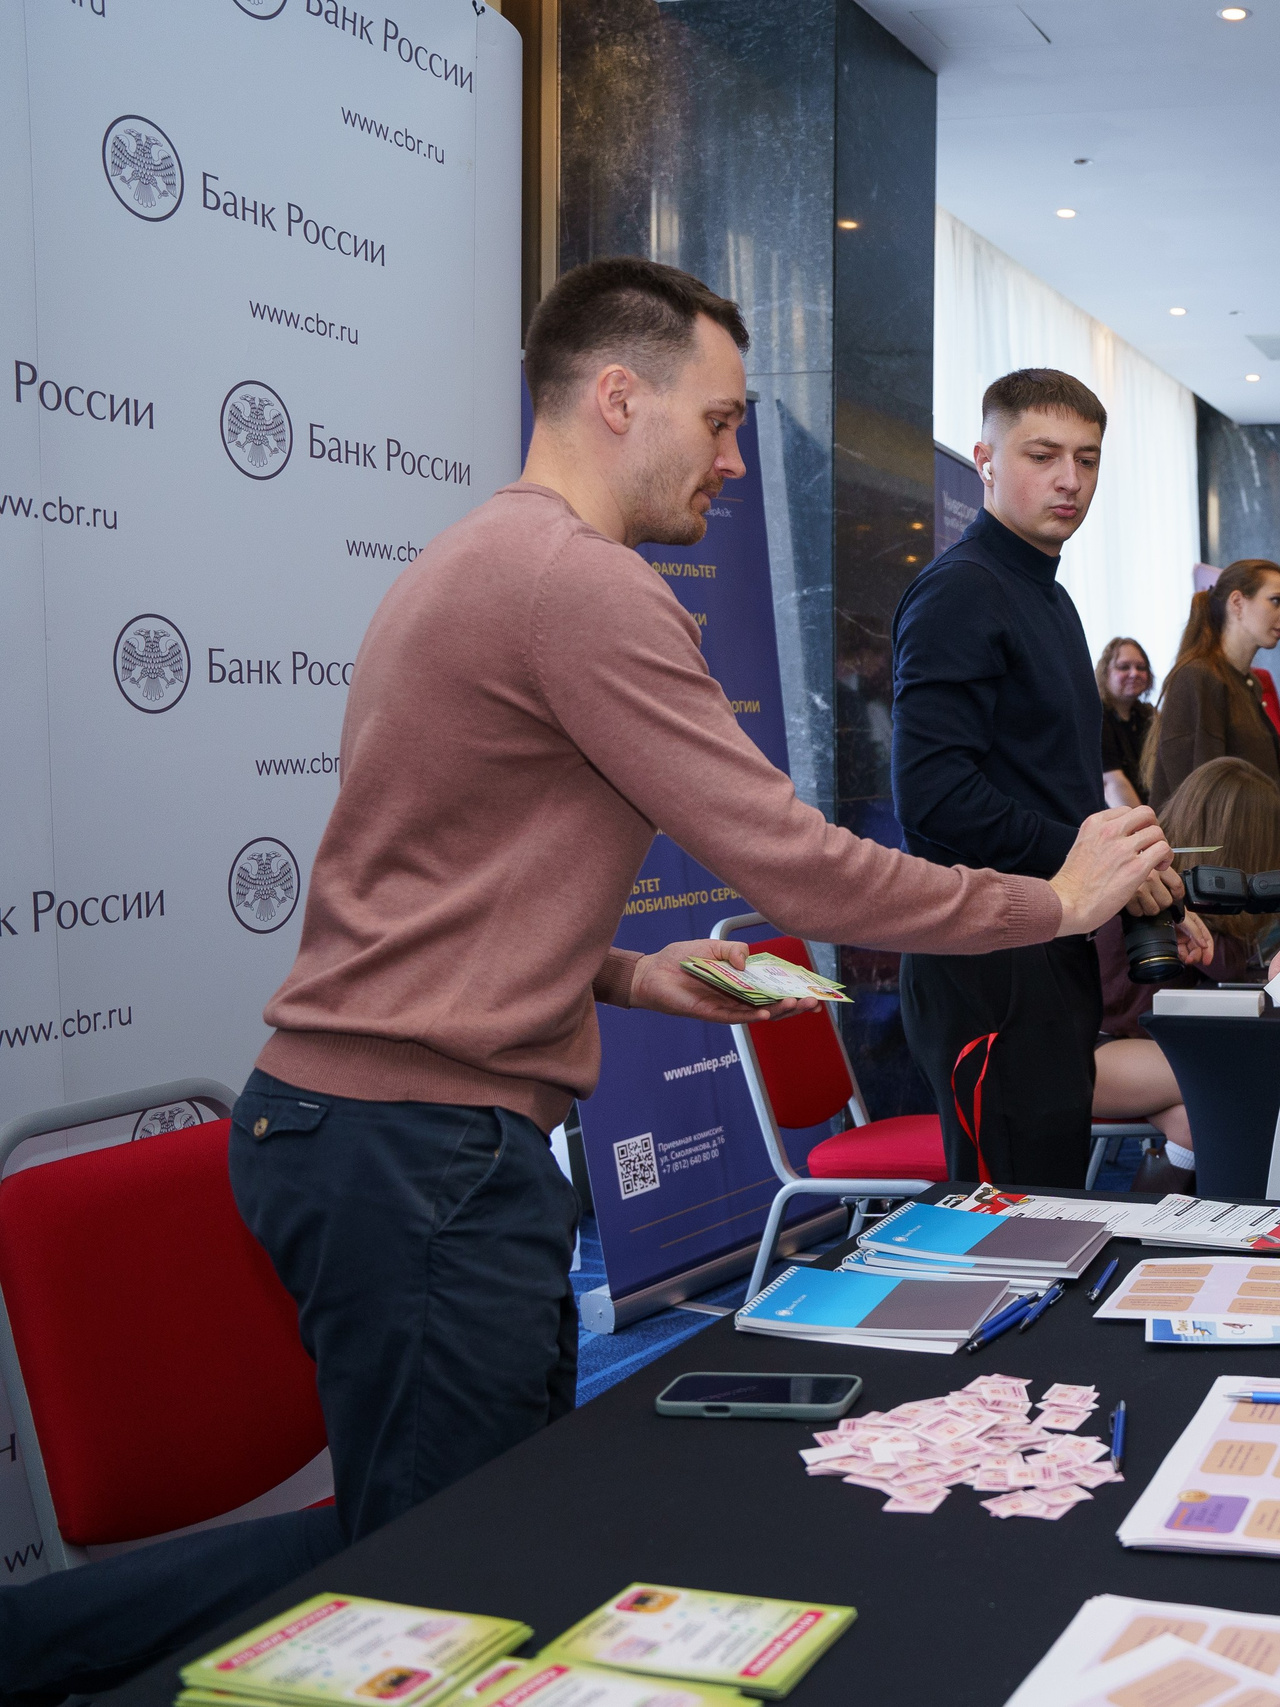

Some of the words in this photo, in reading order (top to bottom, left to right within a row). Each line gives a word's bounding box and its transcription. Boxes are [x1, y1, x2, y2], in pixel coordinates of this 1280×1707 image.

[383, 18, 473, 93] России
[341, 106, 445, 164] www.cbr.ru
[201, 171, 277, 233] Банк
[287, 202, 386, 267] России
[249, 300, 359, 345] www.cbr.ru
[14, 359, 154, 430] России
[309, 423, 377, 470] Банк
[386, 438, 471, 486] России
[651, 561, 717, 578] ФАКУЛЬТЕТ
[208, 648, 282, 685] Банк
[255, 751, 339, 776] www.cbr
[32, 889, 165, 933] России
[621, 890, 708, 916] МОБИЛЬНОГО
[710, 887, 743, 902] СЕРВ
[0, 1006, 132, 1049] ww.cbr.ru
[658, 1136, 692, 1153] Приемная
[662, 1164, 671, 1174] +7
[672, 1158, 689, 1173] (812)
